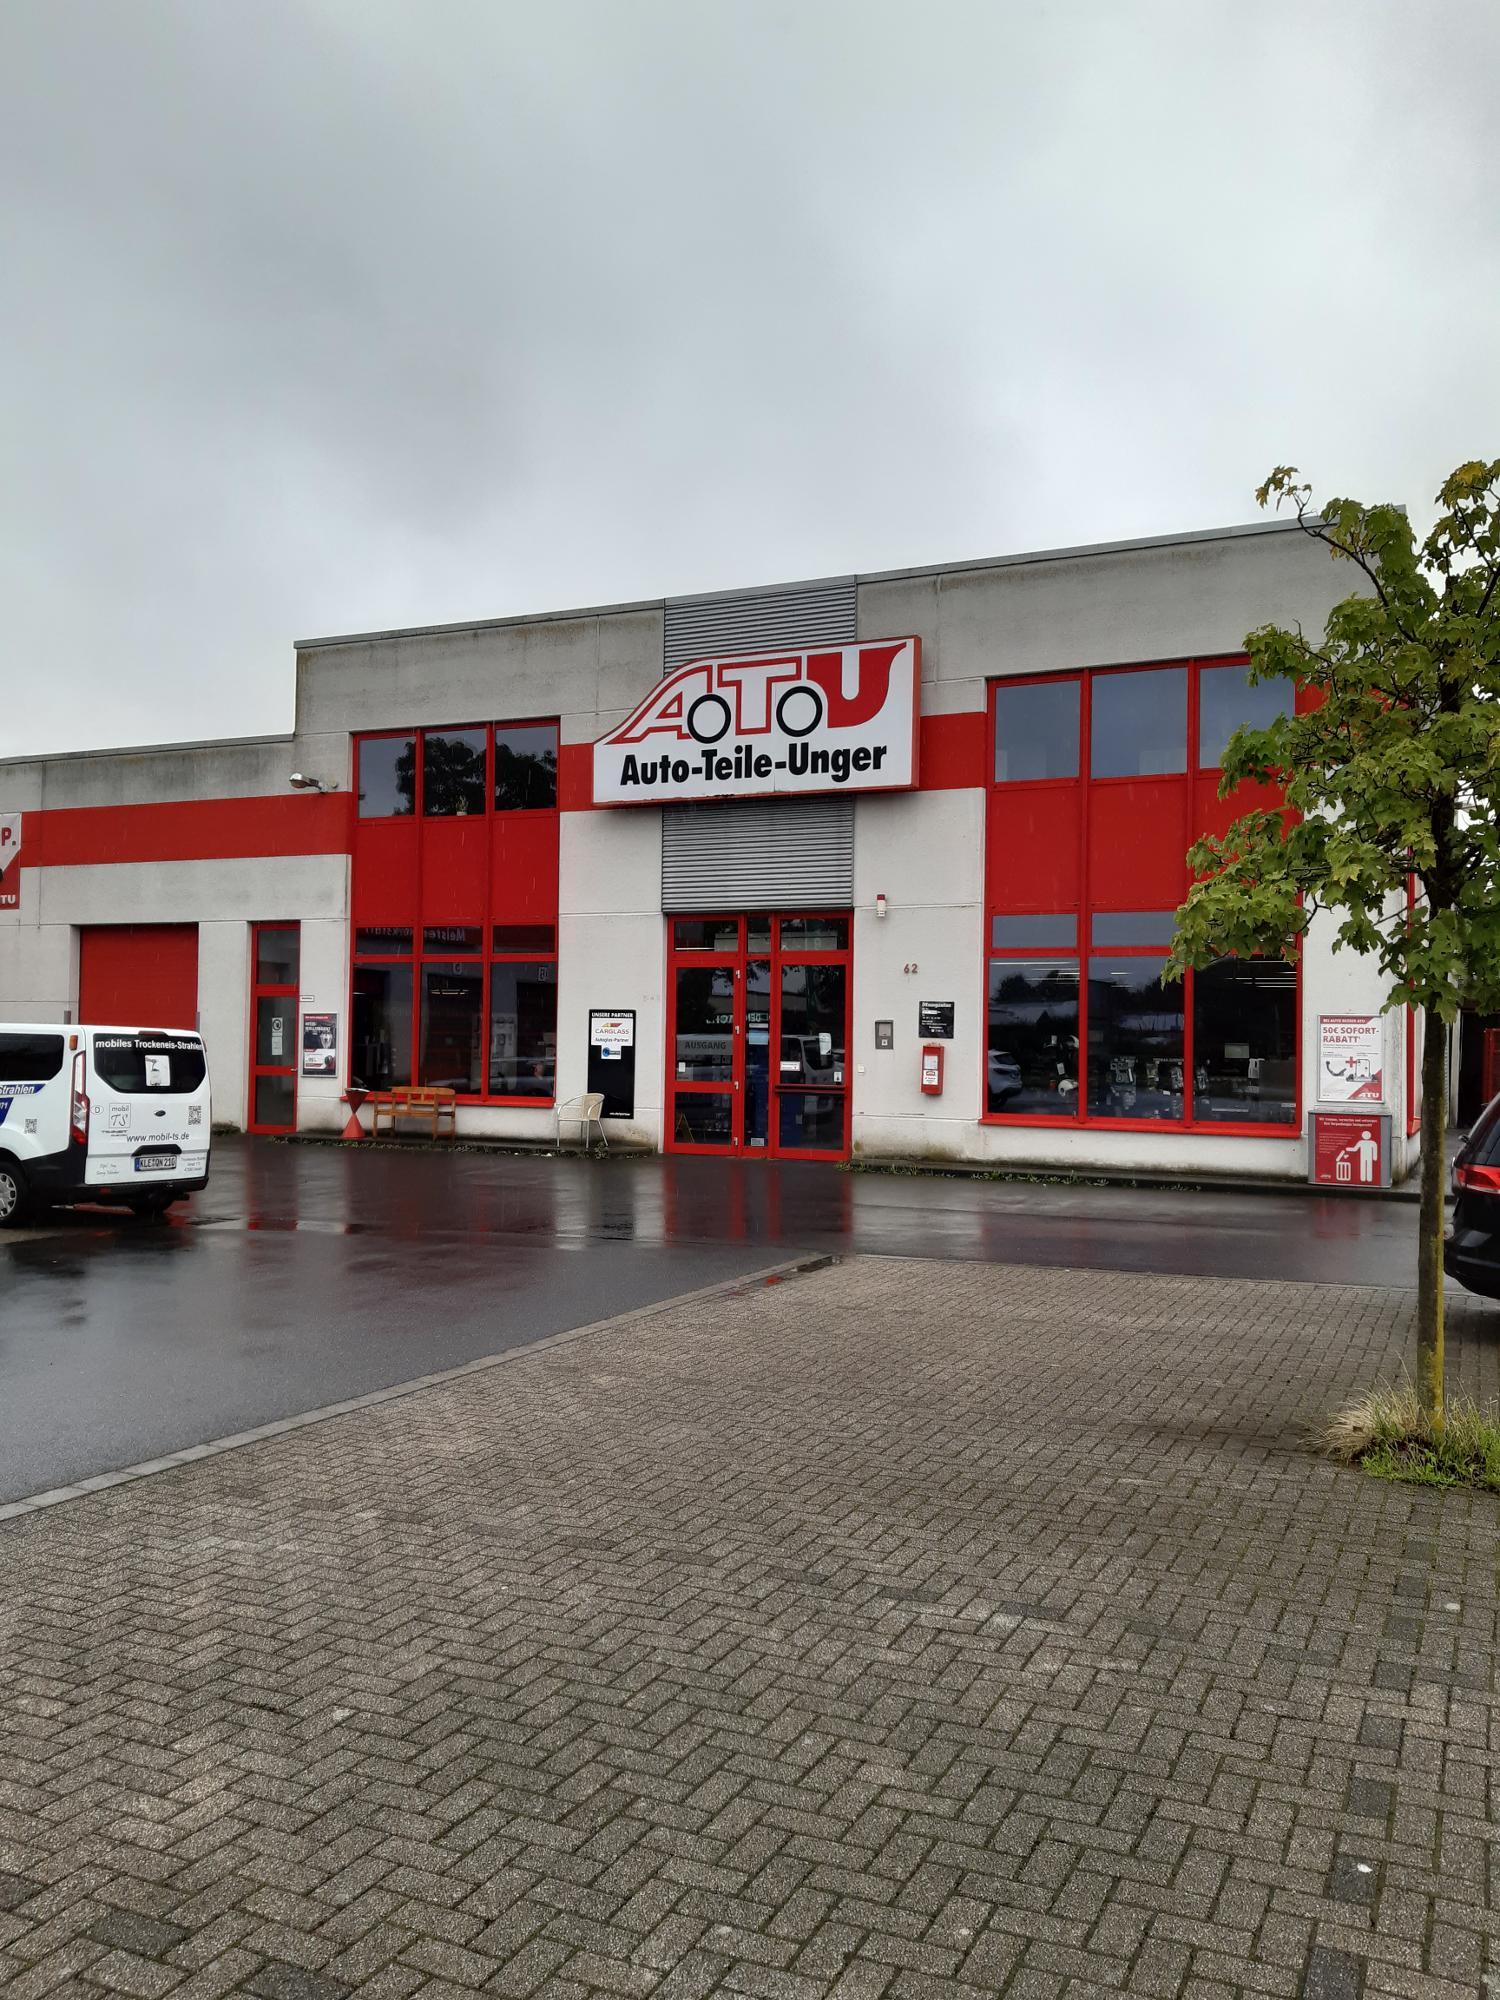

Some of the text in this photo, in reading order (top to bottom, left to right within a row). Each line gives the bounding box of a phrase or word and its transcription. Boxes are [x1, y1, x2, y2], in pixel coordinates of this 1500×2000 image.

[604, 642, 908, 745] ATU
[620, 743, 887, 785] Auto-Teile-Unger
[903, 963, 918, 974] 62
[1322, 1026, 1380, 1035] 50€ SOFORT-
[95, 1038, 132, 1048] mobiles
[684, 1039, 728, 1050] AUSGANG
[110, 1114, 129, 1127] TS
[126, 1132, 190, 1143] www.mobil-ts.de
